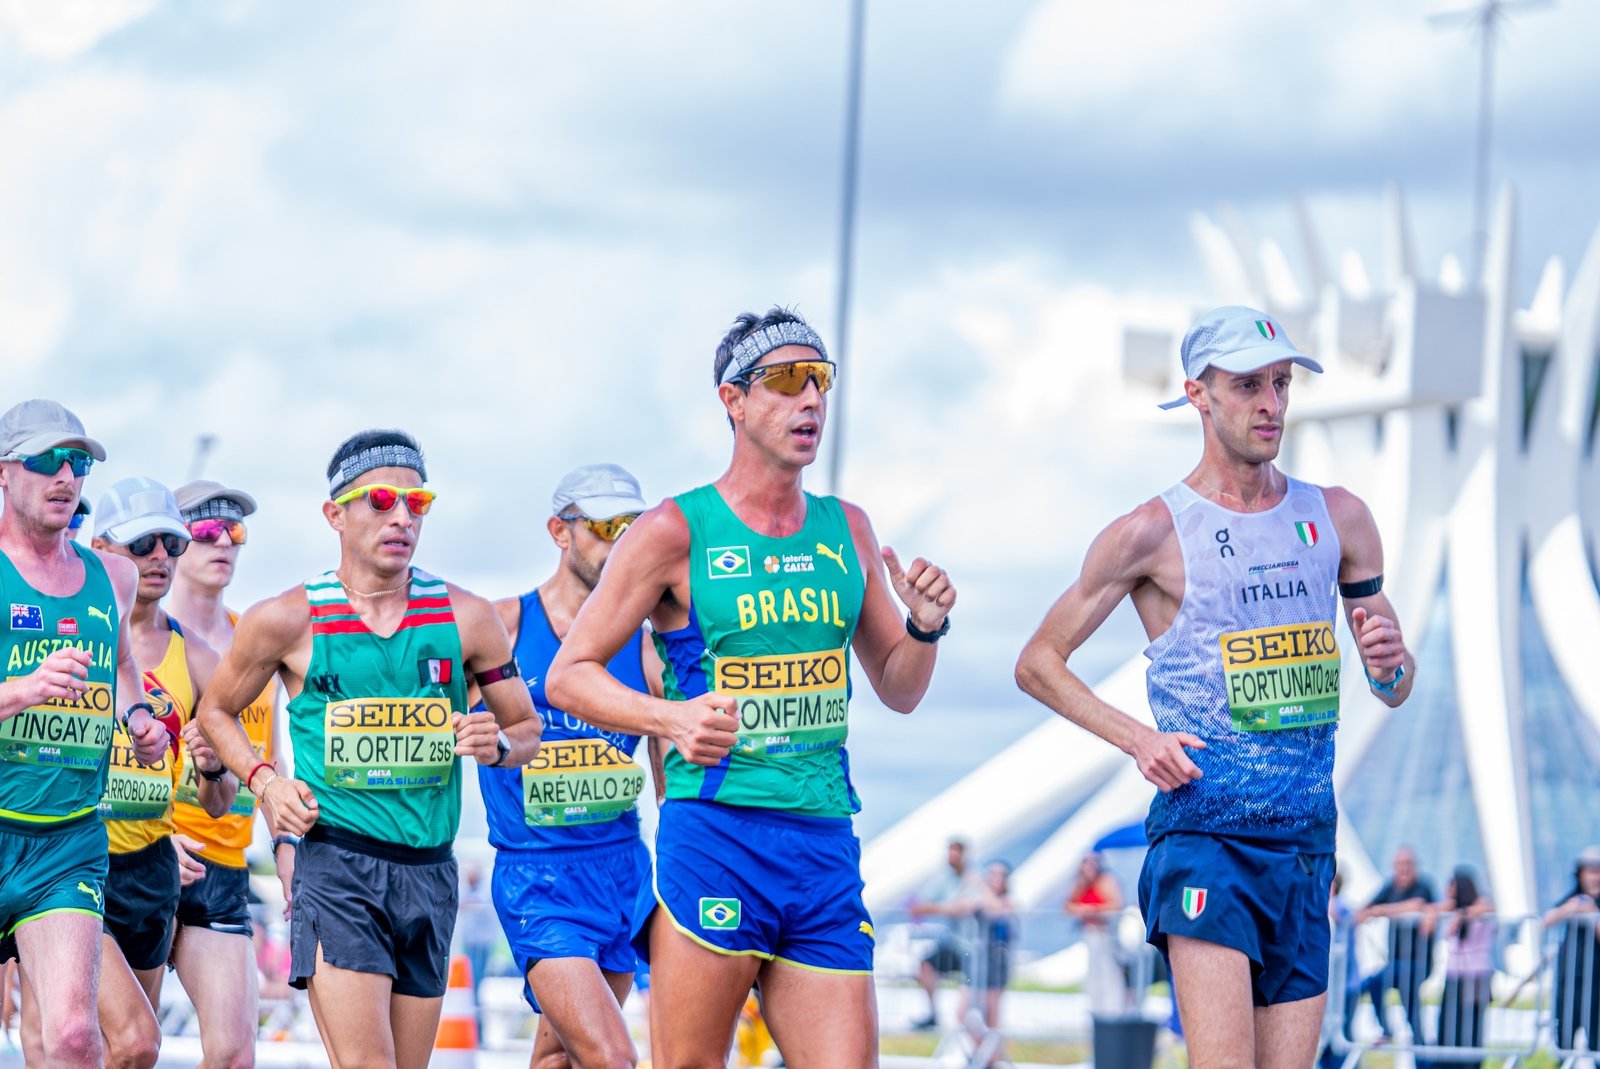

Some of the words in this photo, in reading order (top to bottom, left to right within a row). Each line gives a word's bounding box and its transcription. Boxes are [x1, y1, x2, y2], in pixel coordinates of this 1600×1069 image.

[782, 553, 814, 563] loterias
[783, 562, 815, 573] CAIXA
[1248, 560, 1299, 573] FRECCIAROSSA
[1242, 580, 1308, 604] ITALIA
[737, 588, 846, 631] BRASIL
[1227, 626, 1336, 665] SEIKO
[721, 655, 841, 690] SEIKO
[1230, 664, 1323, 704] FORTUNATO
[1325, 668, 1339, 693] 242
[330, 703, 447, 727] SEIKO
[740, 695, 821, 730] ONFIM
[826, 698, 845, 723] 205
[11, 713, 90, 743] TINGAY
[331, 736, 349, 762] R.
[356, 736, 424, 762] ORTIZ
[429, 741, 451, 762] 256
[149, 783, 169, 801] 222
[528, 774, 617, 804] ARÉVALO
[622, 776, 642, 796] 218
